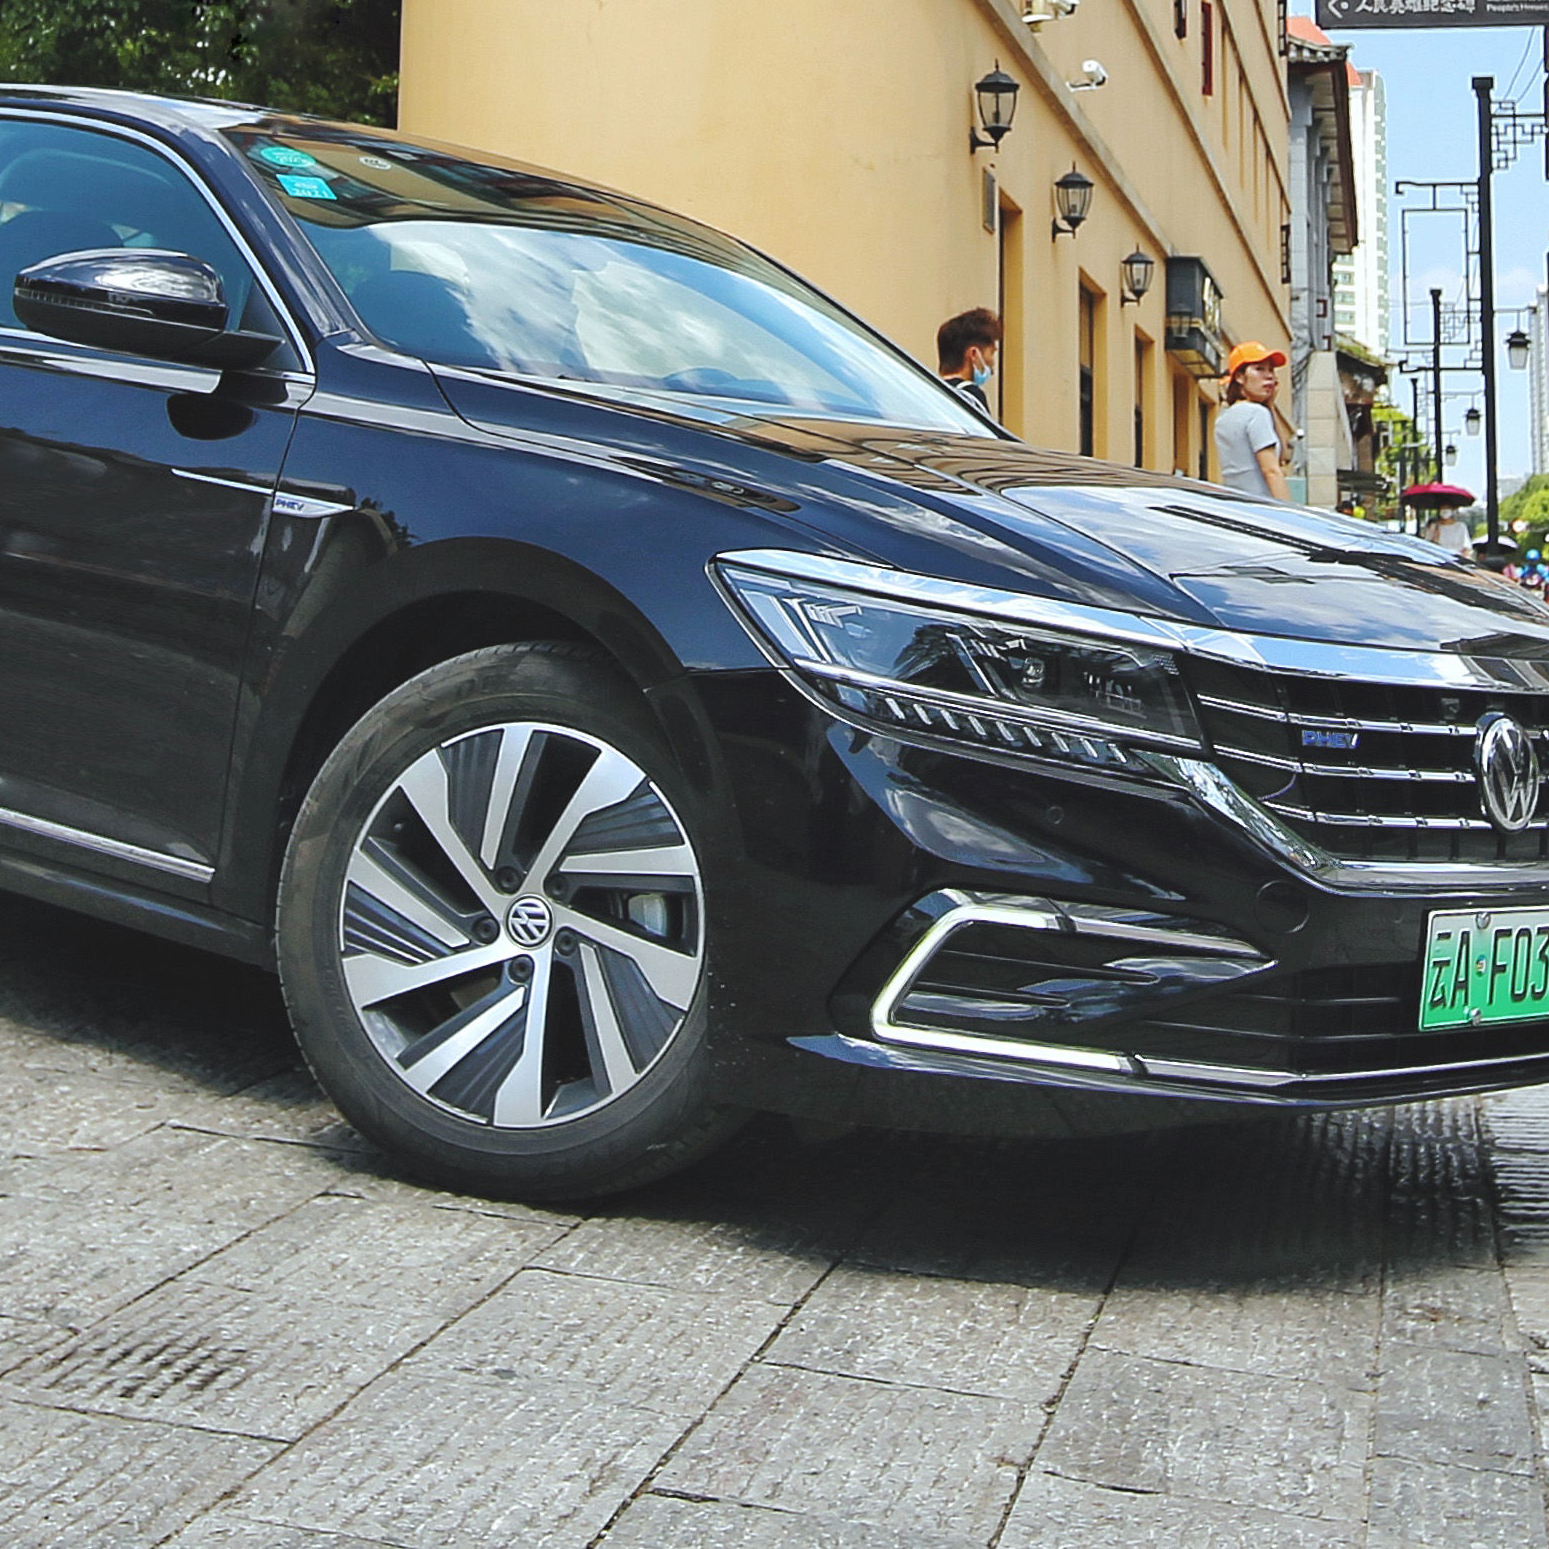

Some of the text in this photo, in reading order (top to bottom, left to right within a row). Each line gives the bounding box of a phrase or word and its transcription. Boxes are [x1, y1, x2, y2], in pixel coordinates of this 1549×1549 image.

[1486, 3, 1520, 14] People's
[275, 498, 305, 511] PHEV
[1301, 730, 1358, 749] PHEV
